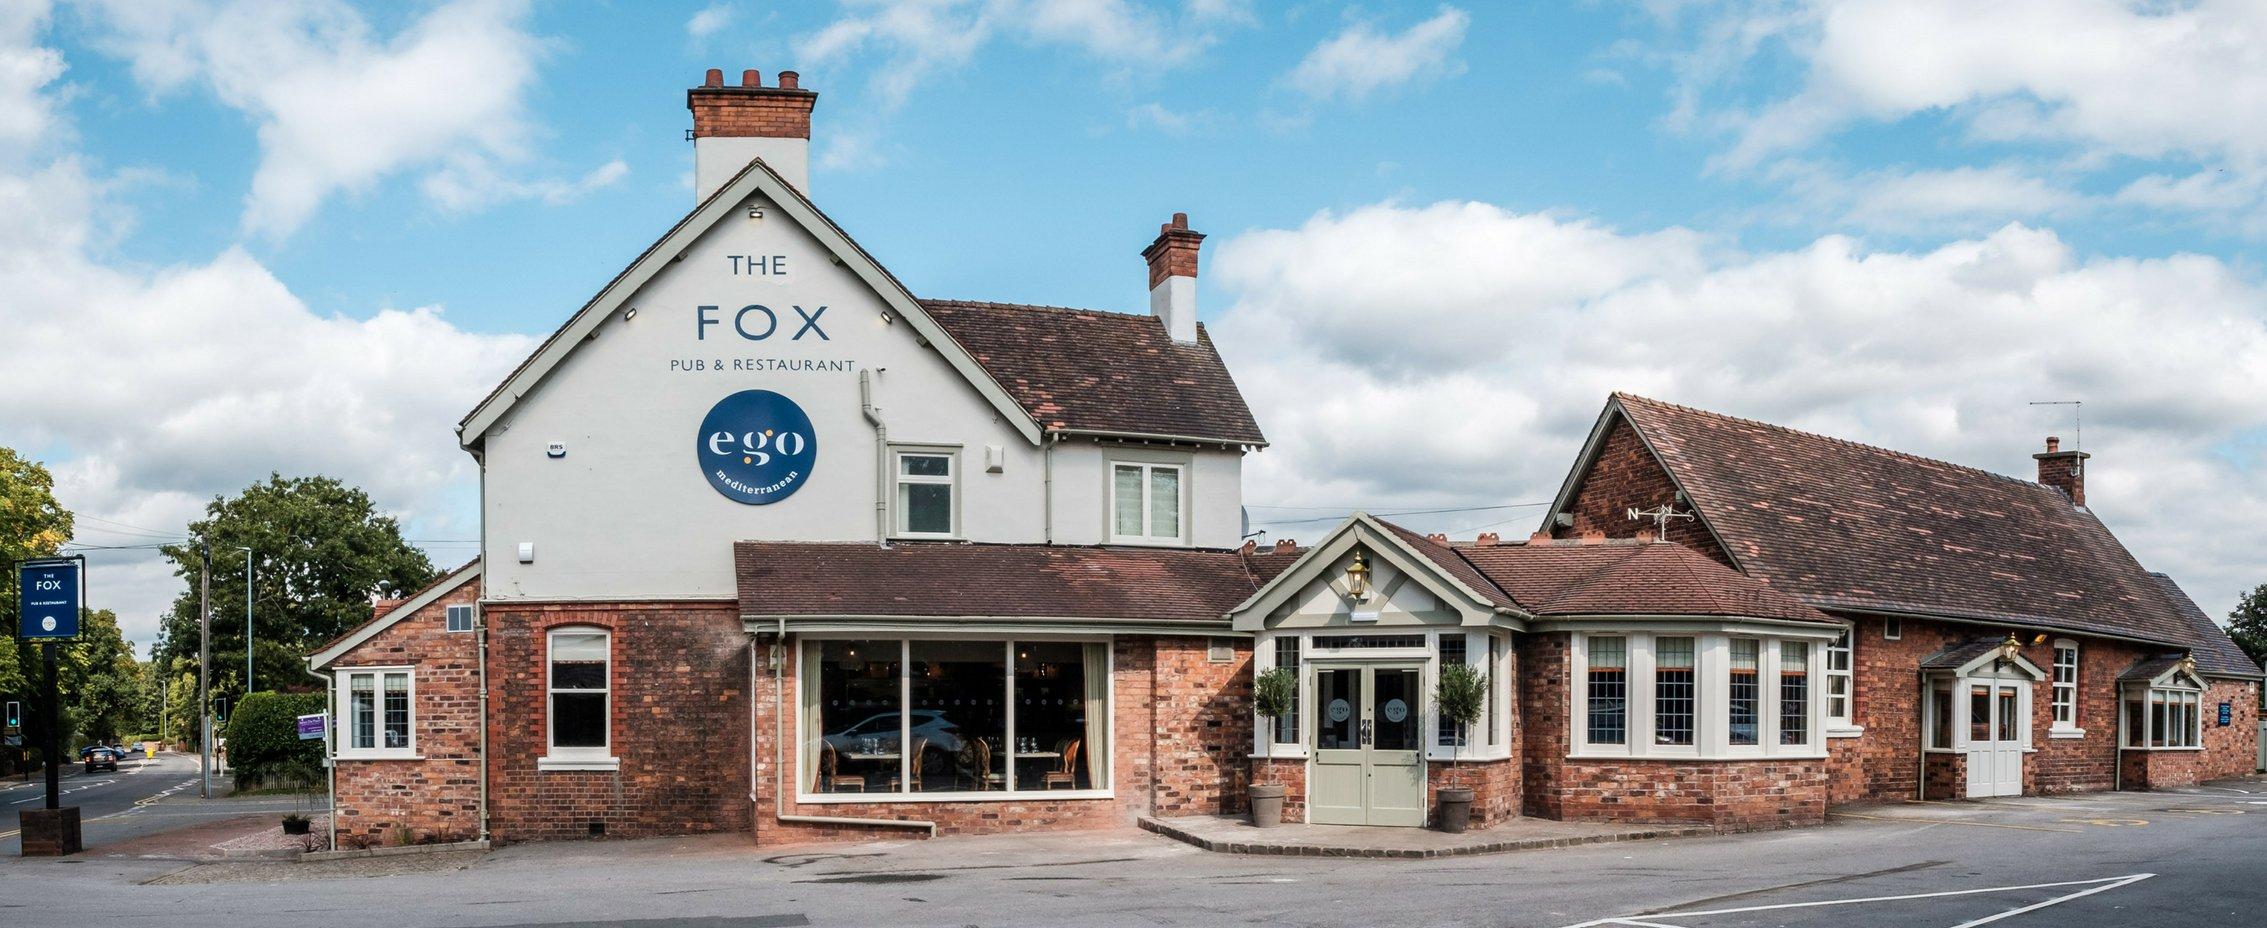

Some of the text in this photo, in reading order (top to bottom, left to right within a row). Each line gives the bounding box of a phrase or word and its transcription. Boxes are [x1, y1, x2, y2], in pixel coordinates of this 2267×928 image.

[727, 255, 787, 276] THE
[697, 304, 830, 341] FOX
[671, 358, 855, 372] PUB & RESTAURANT
[709, 429, 804, 466] ego
[716, 469, 798, 495] mediterranean
[1627, 507, 1695, 522] N S
[36, 580, 61, 590] FOX
[1331, 706, 1348, 714] ego
[1387, 706, 1405, 714] ego
